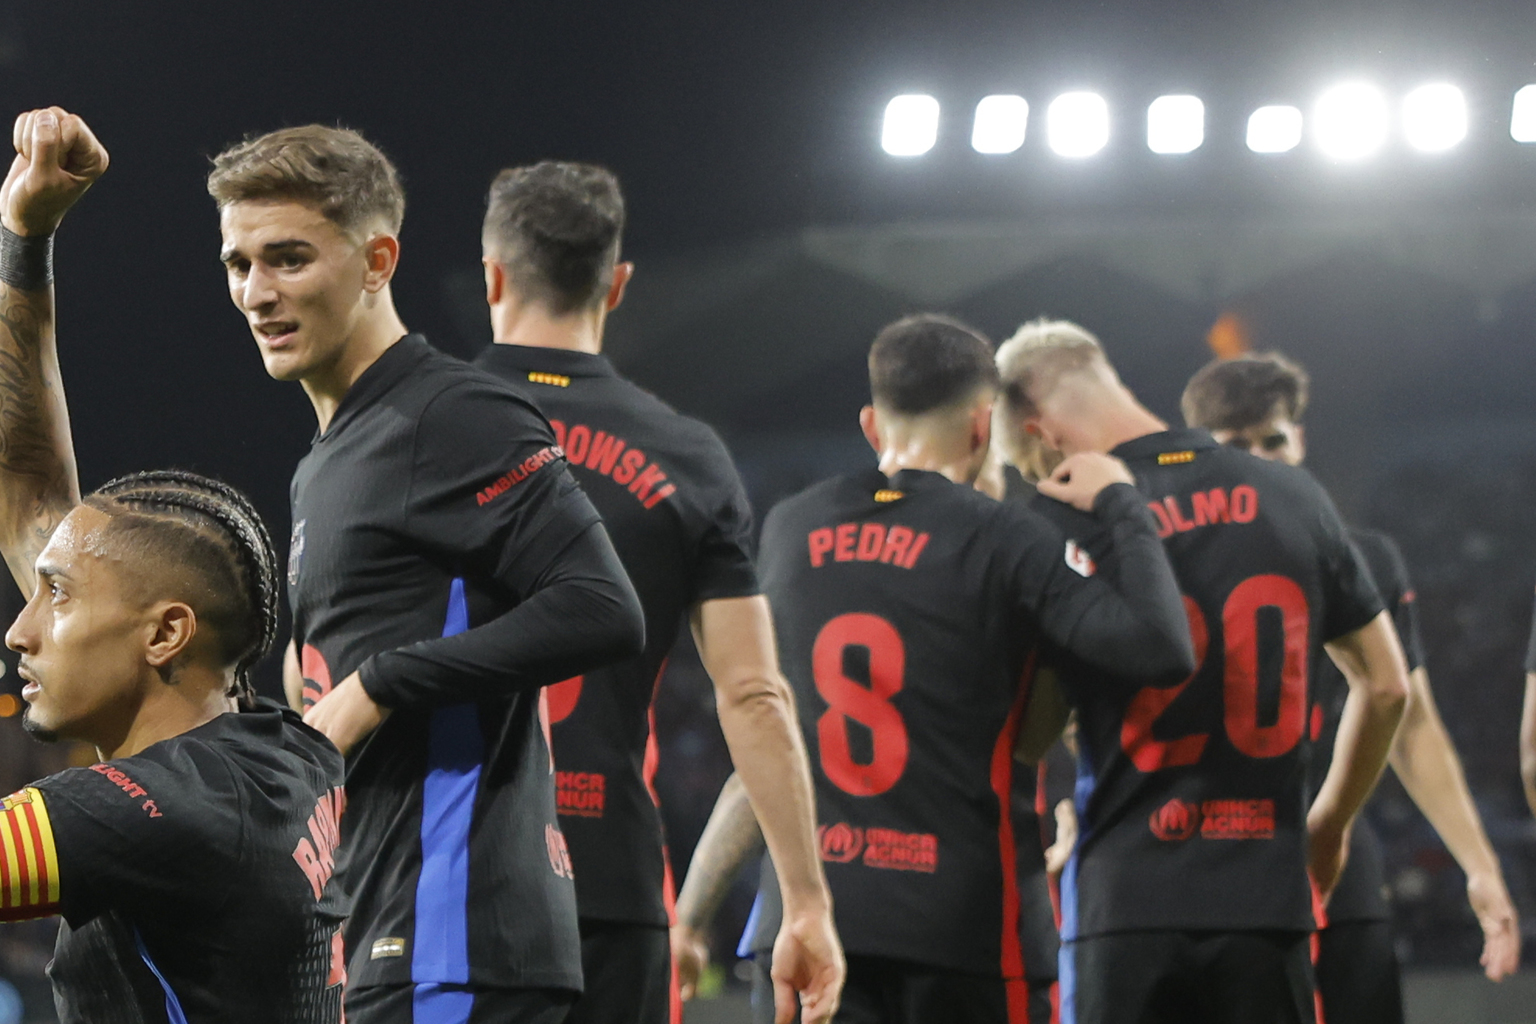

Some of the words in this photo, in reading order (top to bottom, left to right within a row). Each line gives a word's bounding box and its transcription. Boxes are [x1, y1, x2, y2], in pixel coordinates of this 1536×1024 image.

[476, 447, 555, 506] AMBILIGHT
[808, 522, 931, 569] PEDRI
[1121, 574, 1309, 772] 20
[812, 612, 908, 796] 8
[1200, 816, 1275, 832] ACNUR
[864, 845, 938, 865] ACNUR
